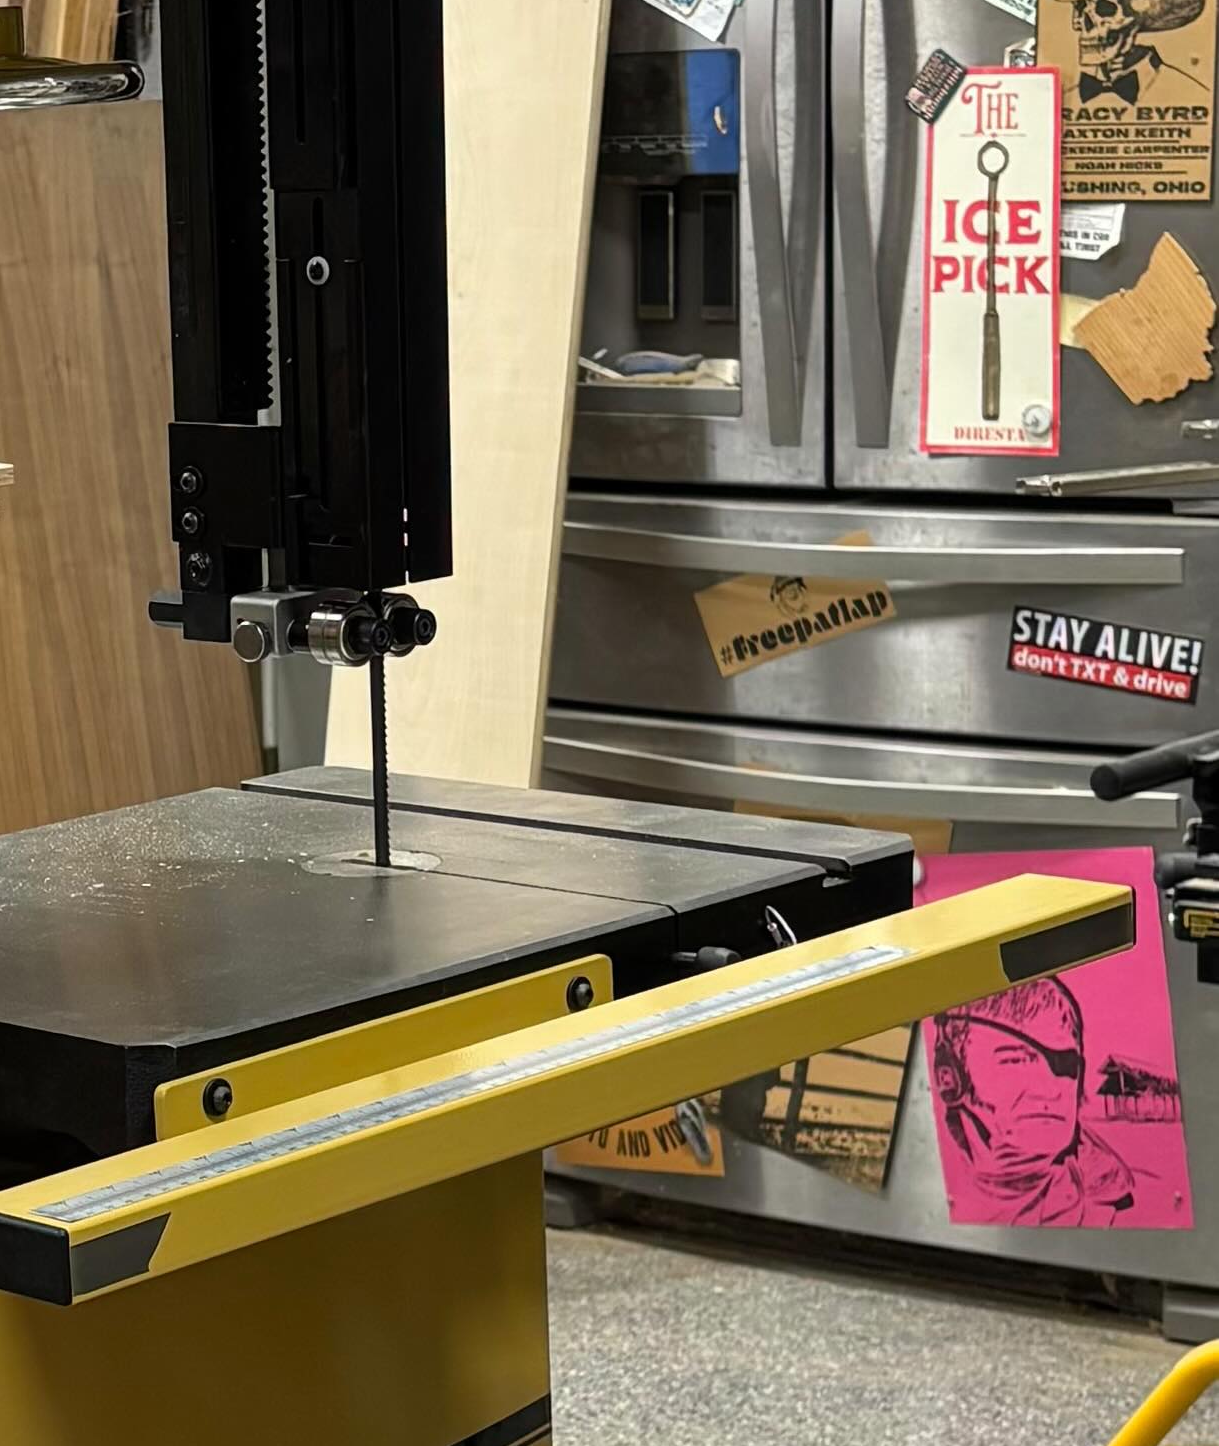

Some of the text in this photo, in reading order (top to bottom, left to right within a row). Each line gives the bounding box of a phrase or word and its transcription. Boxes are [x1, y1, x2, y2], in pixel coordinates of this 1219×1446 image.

[961, 81, 1019, 136] THE
[1061, 105, 1209, 122] RACY BYRD
[942, 199, 1042, 244] ICE
[932, 255, 1050, 295] PICK
[1013, 609, 1202, 676] STAY ALIVE!
[1013, 647, 1189, 699] don't TXT & drive
[616, 1128, 651, 1158] AND
